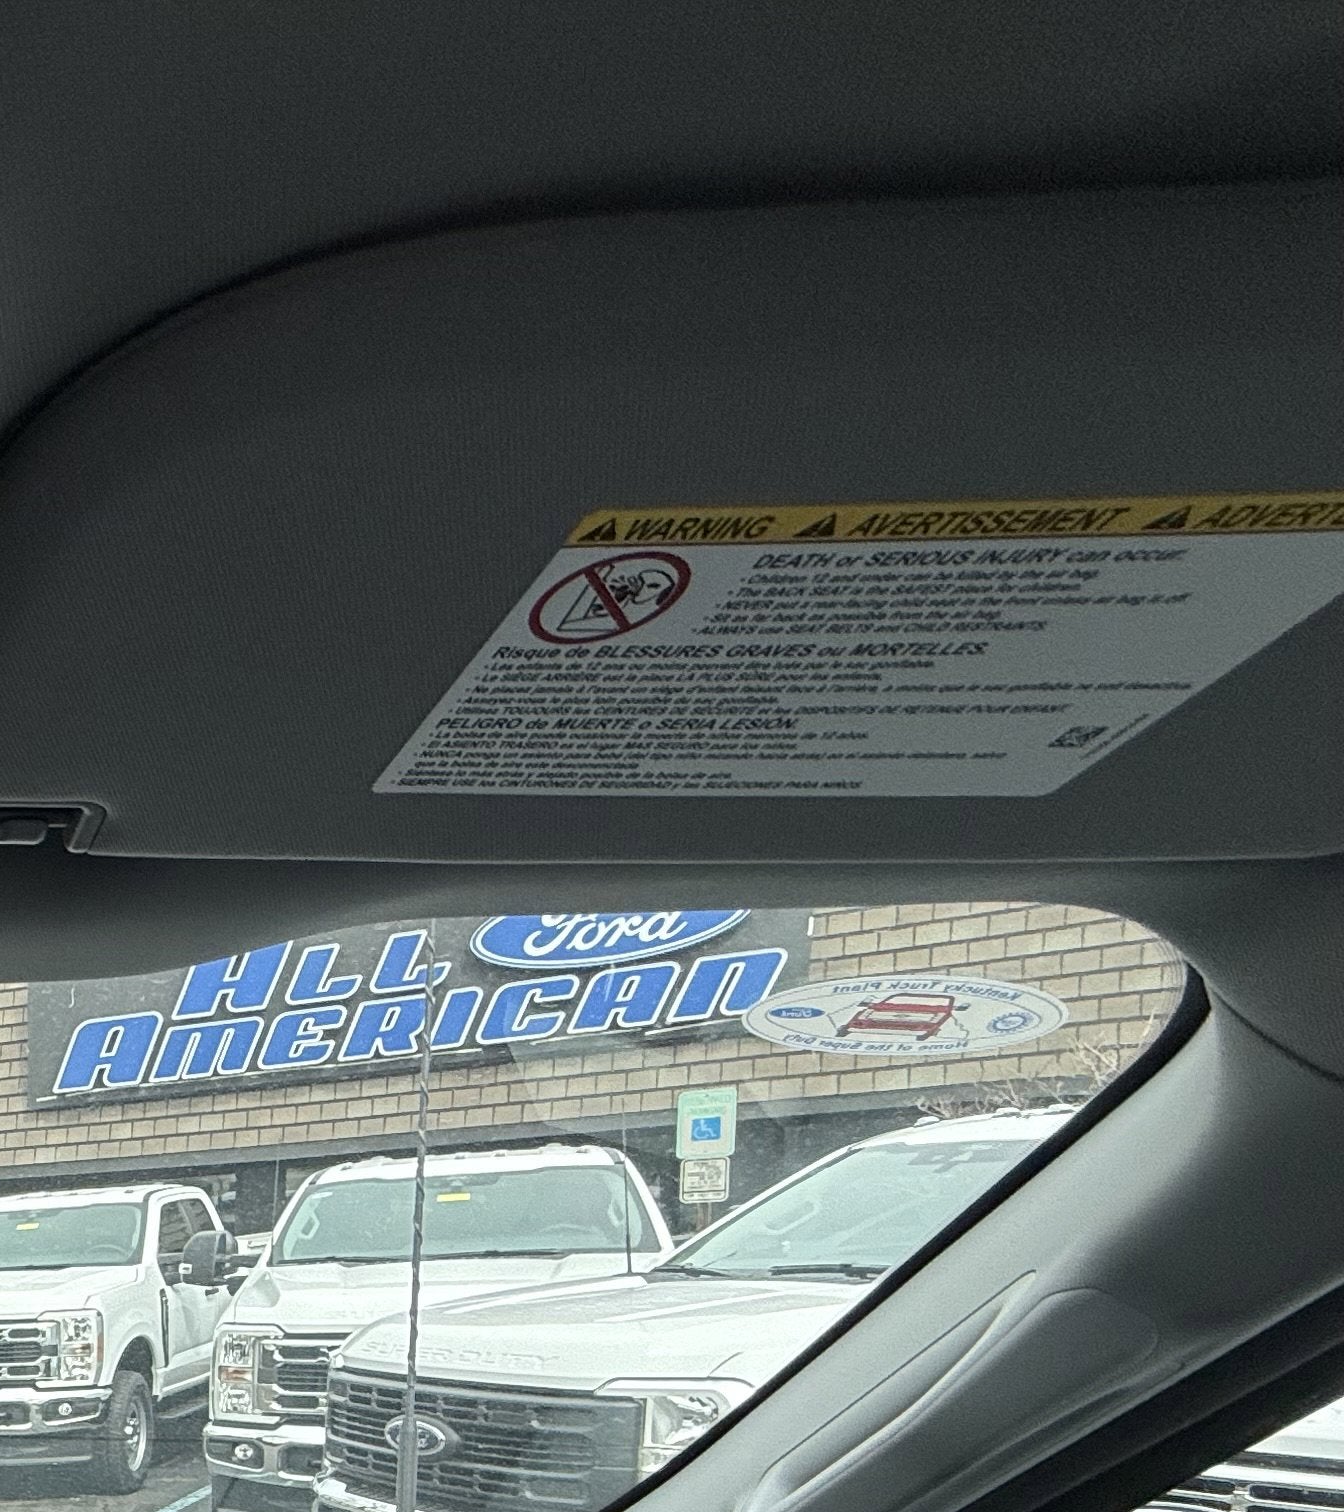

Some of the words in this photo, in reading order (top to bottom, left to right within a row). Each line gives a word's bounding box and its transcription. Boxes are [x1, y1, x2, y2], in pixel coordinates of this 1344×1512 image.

[623, 515, 775, 542] WARNING
[846, 505, 1132, 539] AVERTISSEMENT
[752, 552, 838, 569] DEATH
[864, 549, 976, 567] SERIOUS
[972, 548, 1072, 565] INJURY
[593, 644, 724, 659] BLESSURES
[724, 643, 817, 658] GRAVES
[435, 717, 524, 730] PELIGRO
[552, 717, 639, 730] MUERTE
[655, 717, 717, 730] SERIA
[171, 929, 452, 1021] ALL
[51, 947, 789, 1095] AMERICAN
